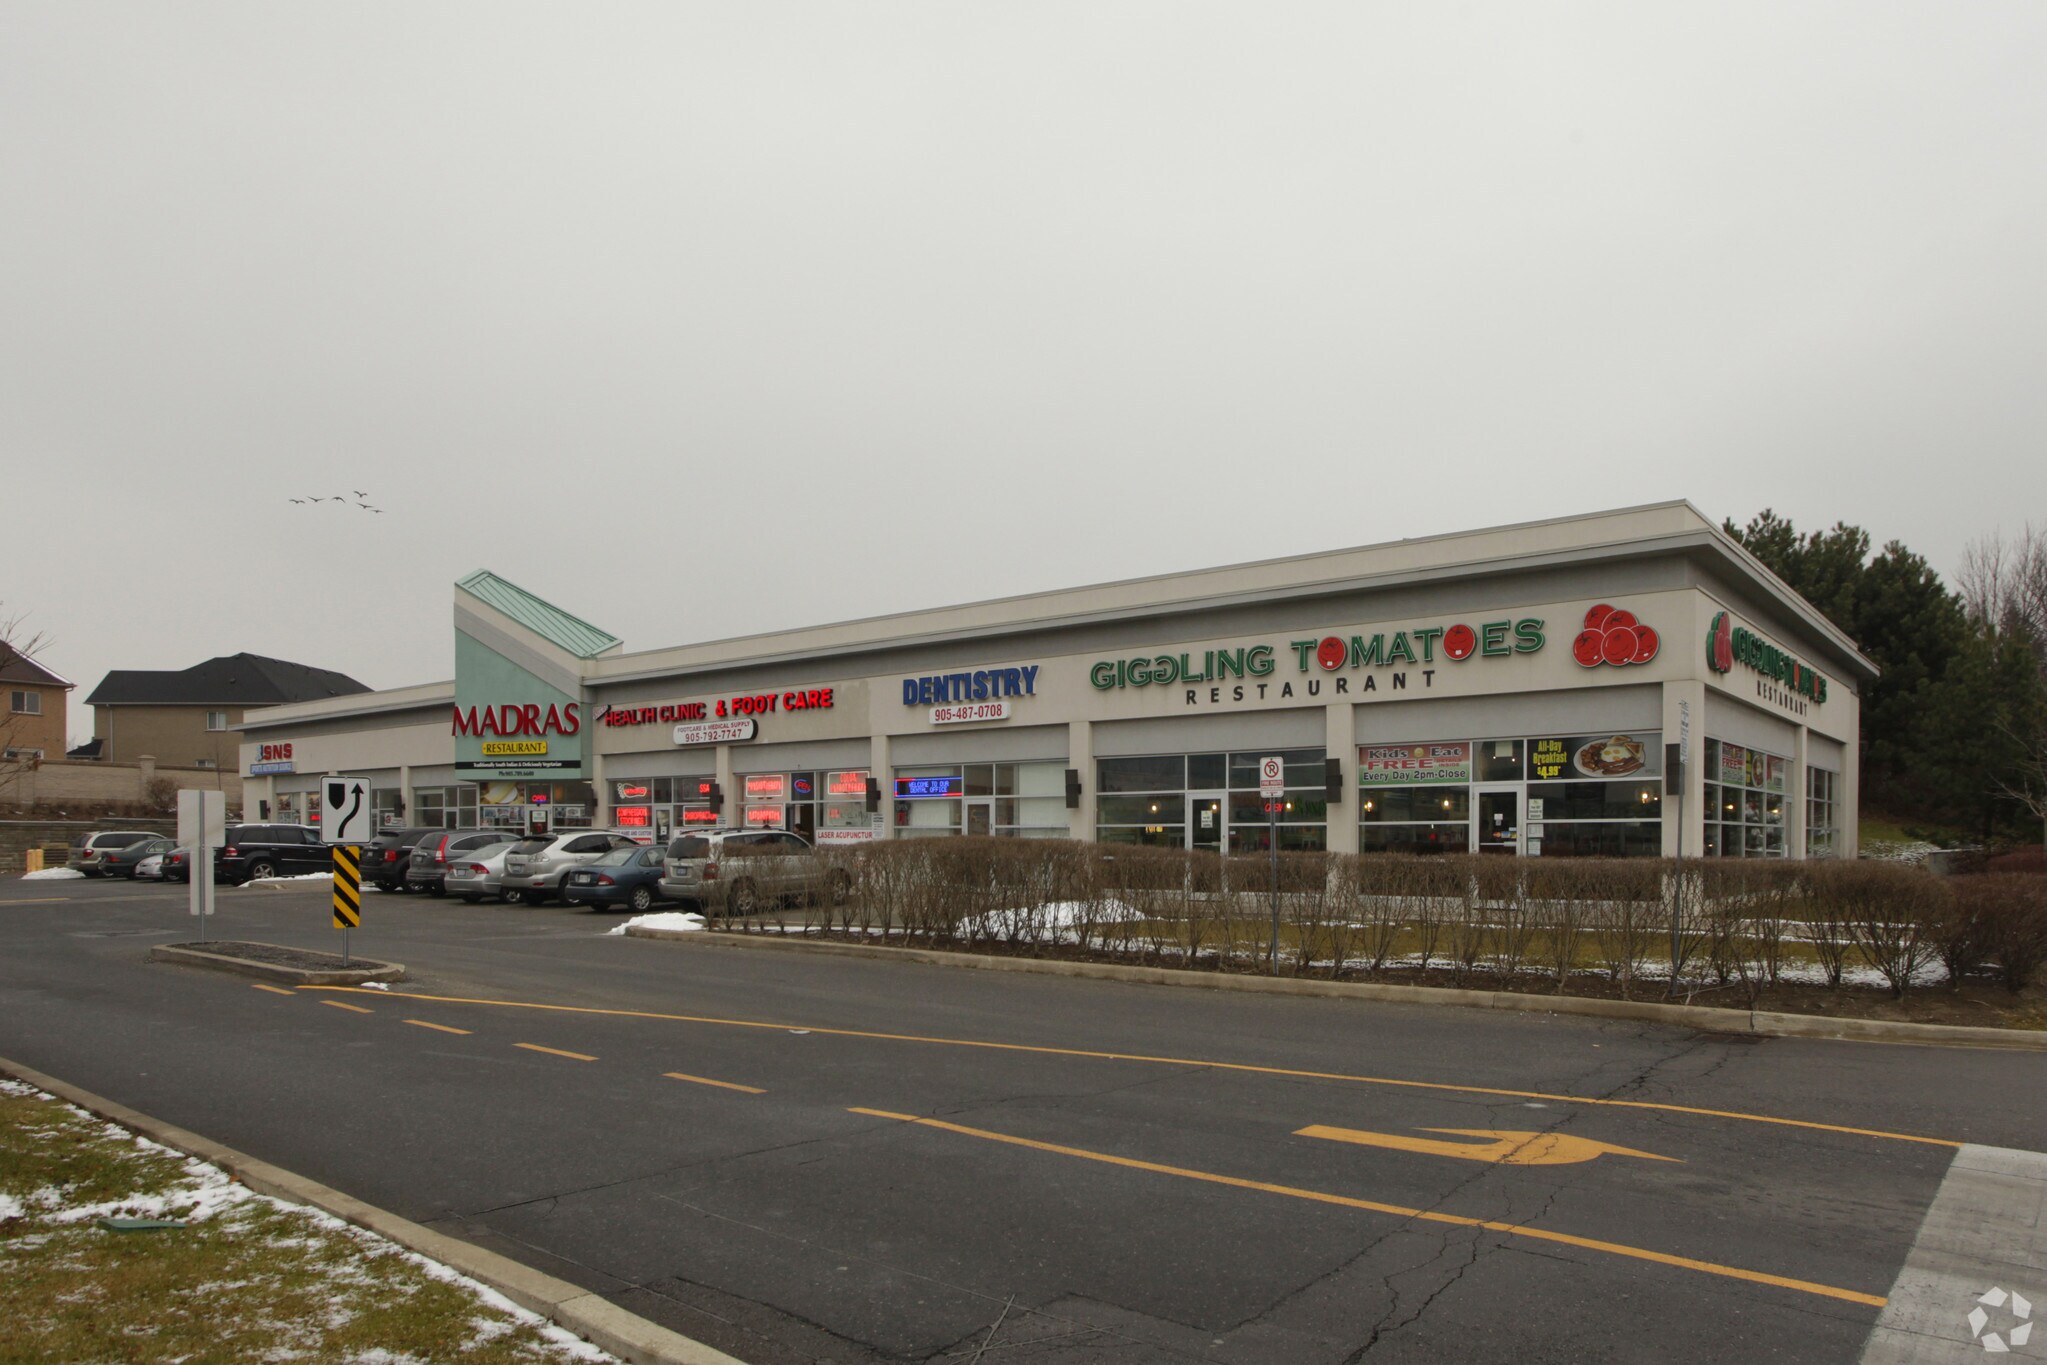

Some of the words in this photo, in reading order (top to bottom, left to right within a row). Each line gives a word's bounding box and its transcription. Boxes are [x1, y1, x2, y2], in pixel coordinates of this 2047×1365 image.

[1090, 645, 1275, 690] GIGGLING
[1291, 617, 1545, 671] TOMATOES
[903, 665, 1039, 706] DENTISTRY
[1186, 669, 1435, 706] RESTAURANT
[1757, 680, 1808, 717] RESTAURANT
[605, 708, 658, 727] HEALTH
[659, 702, 706, 722] CLINIC
[715, 699, 727, 717] &
[732, 694, 778, 716] FOOT
[783, 688, 834, 711] CARE
[934, 704, 1003, 722] 905-487-0708
[452, 702, 581, 737] MADRAS
[677, 725, 702, 733] FOOTCARE
[708, 723, 730, 731] MEDICAL
[730, 720, 751, 728] SUPPLY
[685, 728, 742, 742] 905-792-7747
[263, 743, 293, 761] SNS
[486, 742, 543, 753] RESTAURANT
[1368, 749, 1408, 759] Kids
[1430, 747, 1462, 757] Eat
[1537, 740, 1562, 753] All-Day
[1367, 759, 1434, 770] FREE
[1533, 752, 1567, 764] Breakfast
[1722, 759, 1738, 769] FREE
[1363, 771, 1389, 781] Every
[1392, 771, 1410, 781] Day
[909, 786, 928, 794] DENTAL
[929, 785, 948, 793] OFFICE
[532, 794, 547, 803] OPEN
[1264, 803, 1284, 813] OEN
[836, 831, 873, 839] ACUPUNCTUR
